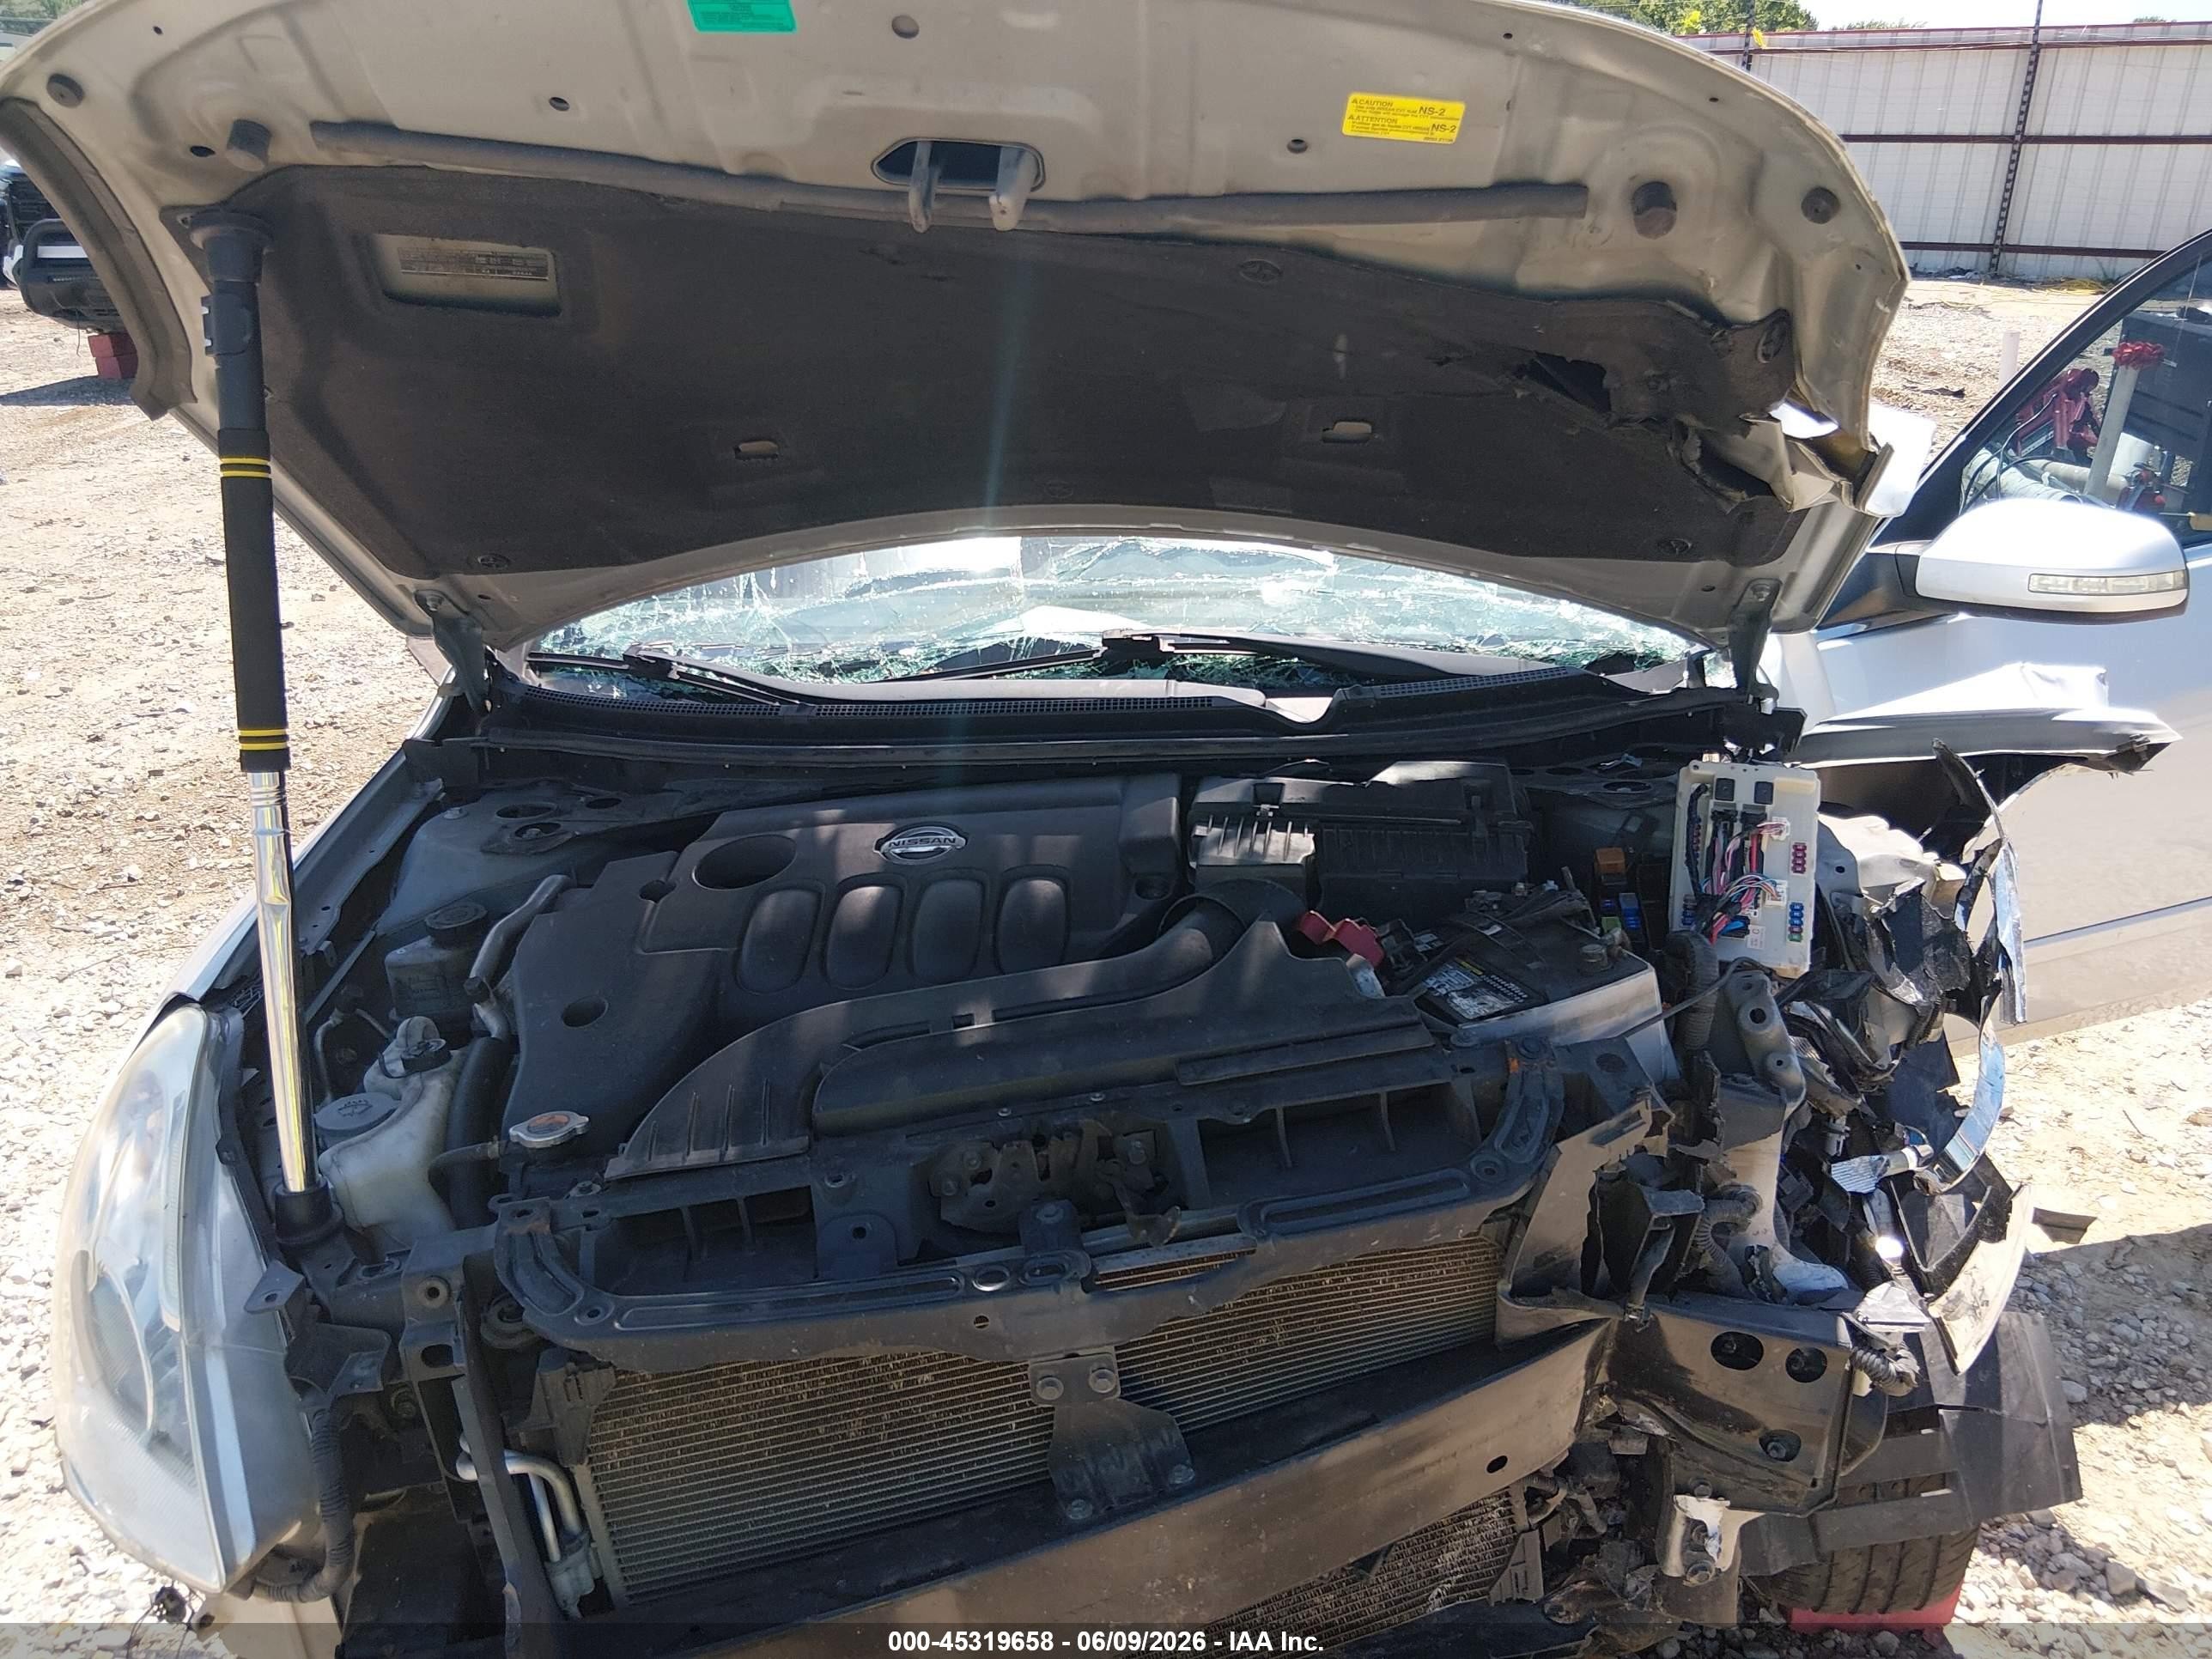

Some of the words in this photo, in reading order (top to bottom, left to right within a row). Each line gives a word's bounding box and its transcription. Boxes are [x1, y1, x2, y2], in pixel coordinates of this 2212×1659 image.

[1419, 106, 1446, 117] NS-2
[1354, 116, 1398, 125] ATTENTION
[1431, 123, 1457, 133] NS-2
[888, 837, 957, 848] NISSAN
